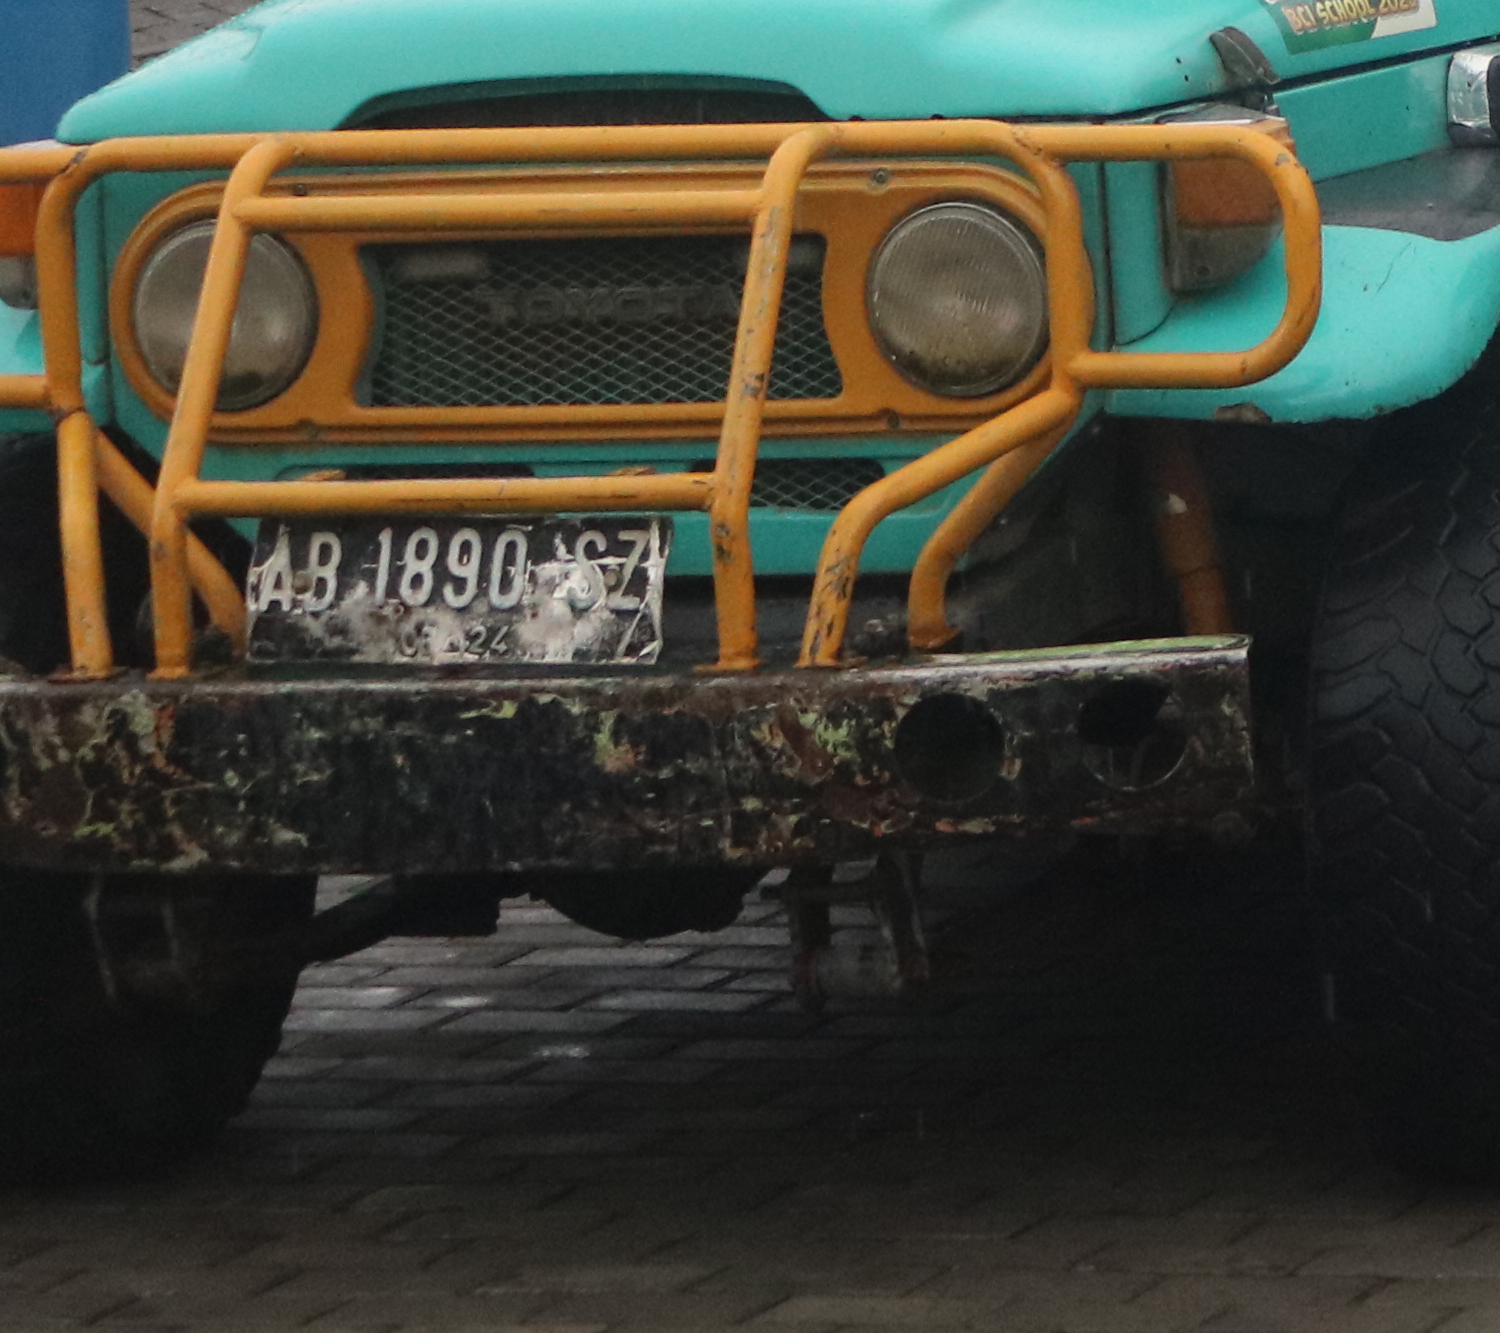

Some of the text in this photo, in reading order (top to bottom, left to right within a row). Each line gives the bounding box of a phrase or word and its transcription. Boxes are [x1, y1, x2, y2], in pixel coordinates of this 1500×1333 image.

[259, 526, 652, 613] AB 1890 SZ
